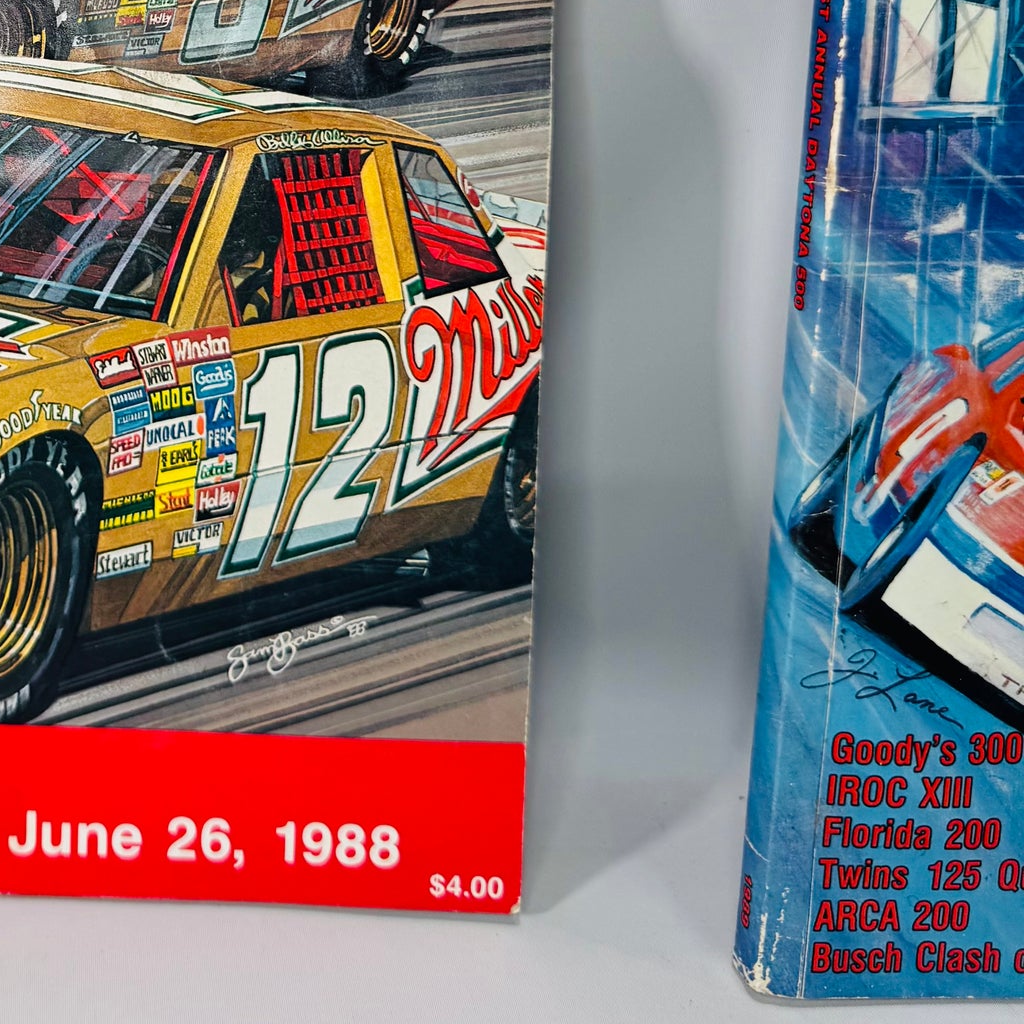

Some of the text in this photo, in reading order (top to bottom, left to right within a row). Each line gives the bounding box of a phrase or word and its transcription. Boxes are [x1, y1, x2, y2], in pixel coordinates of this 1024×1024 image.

[807, 28, 829, 131] ANNUAL
[797, 138, 820, 258] DAYTONA
[792, 265, 807, 311] 500
[171, 333, 231, 362] Winston
[150, 385, 194, 412] MOOG
[146, 419, 196, 446] UNOCAL
[218, 328, 396, 580] 12
[175, 523, 221, 545] VICTOR
[97, 544, 151, 575] Stewart
[831, 732, 1023, 772] Goody's 300
[826, 774, 973, 808] IROC XIII
[8, 810, 143, 858] June
[167, 816, 245, 869] 26,
[275, 821, 400, 868] 1988
[822, 816, 1001, 850] Florida 200
[429, 873, 504, 899] $4.00
[819, 858, 1024, 892] Twins 125 Q
[813, 899, 970, 931] ARCA 200
[811, 941, 902, 973] Busch
[916, 941, 1000, 973] Clash
